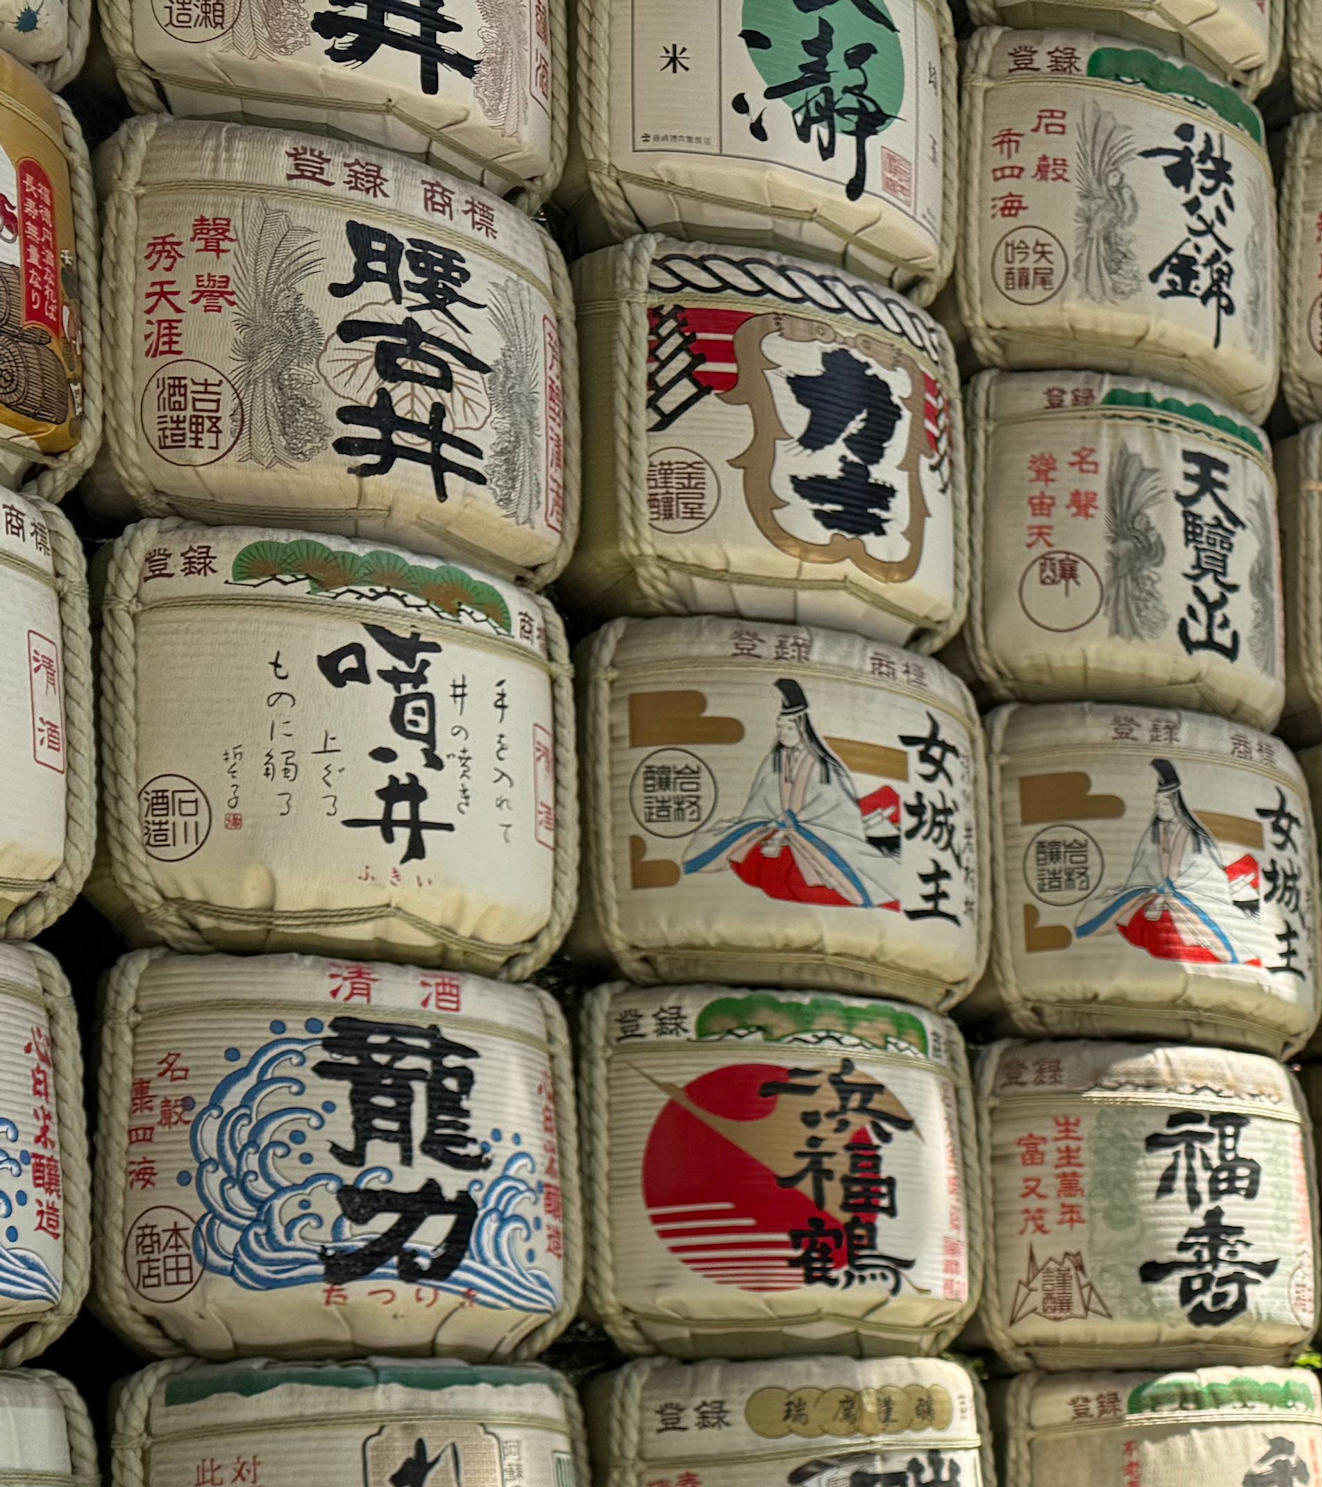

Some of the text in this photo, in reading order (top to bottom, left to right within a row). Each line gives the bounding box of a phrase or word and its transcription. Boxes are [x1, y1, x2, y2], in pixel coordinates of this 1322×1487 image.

[659, 43, 692, 75] 米
[1137, 122, 1236, 349] 秩父錦
[329, 219, 490, 502] 腰古井
[900, 711, 962, 928] 女城主
[1255, 785, 1306, 981] 女城主
[329, 962, 462, 1013] 清酒
[312, 1016, 493, 1285] 龍力
